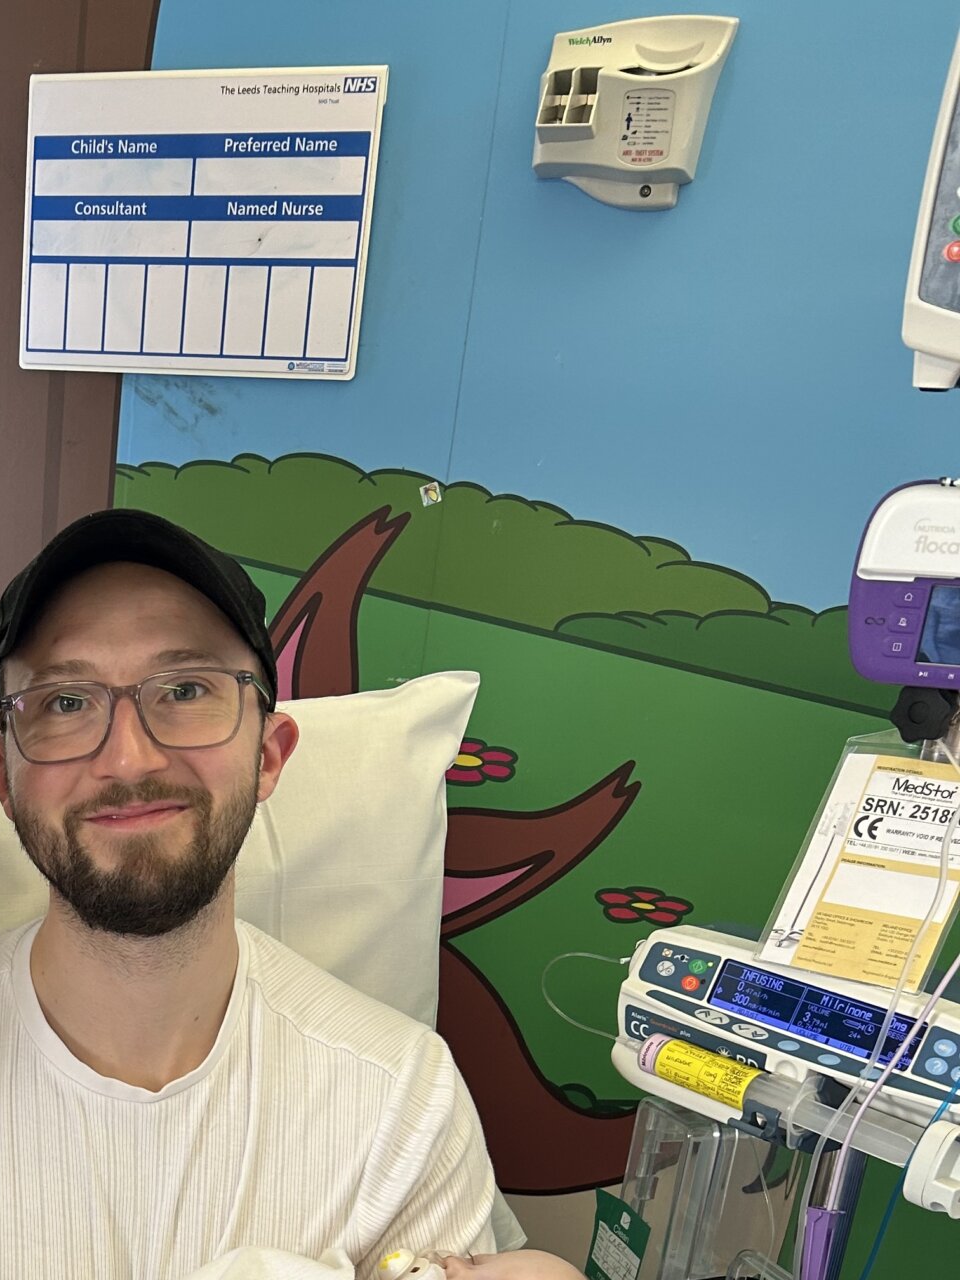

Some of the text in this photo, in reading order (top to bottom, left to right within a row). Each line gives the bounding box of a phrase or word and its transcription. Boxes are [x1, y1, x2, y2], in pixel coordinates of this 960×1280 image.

[568, 35, 613, 47] WelchAllyn
[220, 83, 341, 96] The Leeds Teaching Hospitals
[343, 77, 376, 93] NHS
[71, 139, 158, 154] Child's Name
[224, 136, 338, 152] Preferred Name
[74, 200, 147, 216] Consultant
[227, 200, 324, 216] Named Nurse
[863, 797, 905, 816] SRN:
[740, 969, 784, 992] INFUSING
[820, 995, 873, 1020] Milrinone
[630, 1021, 649, 1039] CC
